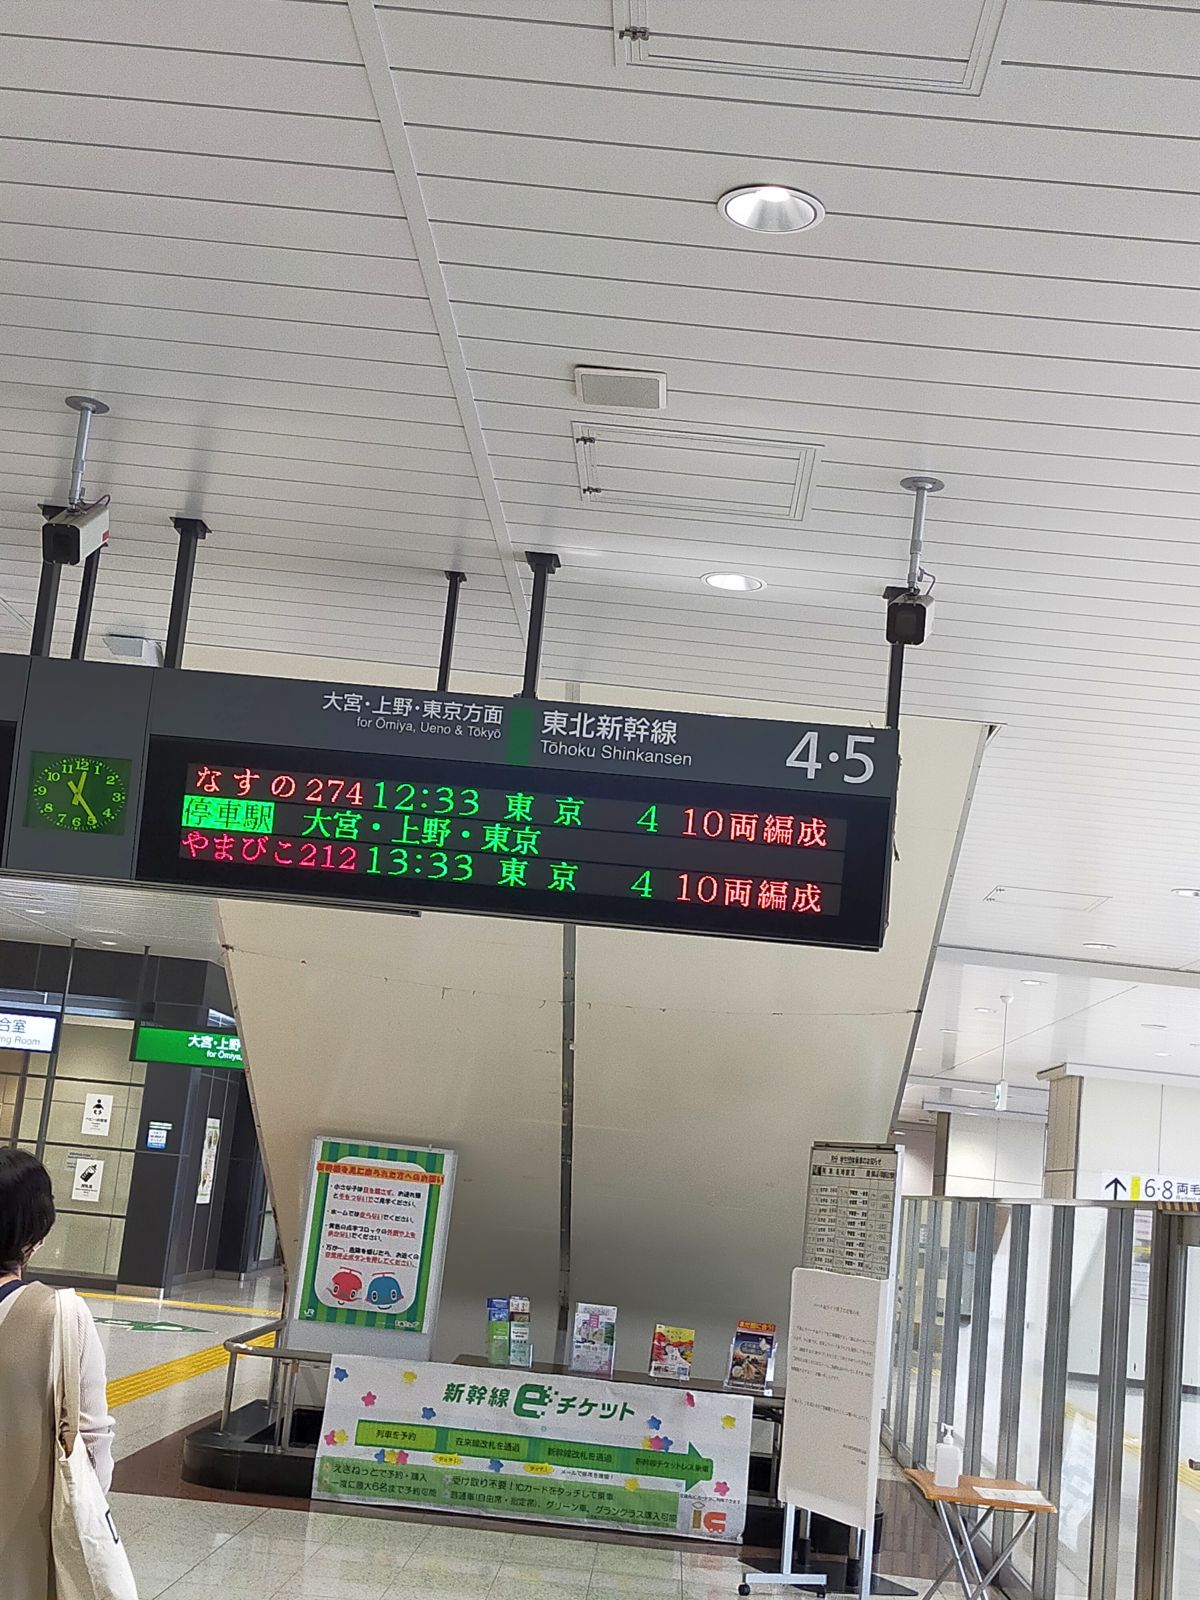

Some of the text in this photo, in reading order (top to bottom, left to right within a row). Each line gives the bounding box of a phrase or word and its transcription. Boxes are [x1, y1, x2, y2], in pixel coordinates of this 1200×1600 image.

[322, 691, 503, 726] 大宮・上野・東京方面
[356, 716, 373, 729] for
[420, 722, 452, 735] Ueno
[455, 725, 465, 737] &
[467, 724, 502, 740] Tōkyō
[541, 709, 678, 746] 東北新幹線
[540, 739, 692, 767] Tōhoku Shinkansen
[61, 764, 73, 773] 11
[75, 761, 89, 770] 12
[94, 765, 100, 774] 1
[47, 771, 60, 781] 10
[105, 775, 115, 785] 2
[37, 785, 47, 795] 9
[112, 792, 121, 801] 3
[43, 802, 53, 812] 8
[102, 807, 111, 817] 4
[57, 813, 66, 823] 7
[183, 797, 273, 833] 停車駅
[374, 781, 480, 817] 12:33
[636, 804, 659, 833] 4
[682, 807, 828, 848] 10両編成
[71, 817, 81, 826] 6
[366, 846, 474, 882] 13:33
[630, 870, 653, 899] 4
[676, 873, 822, 914] 10両編成
[15, 1036, 41, 1046] Room
[206, 1049, 217, 1058] for
